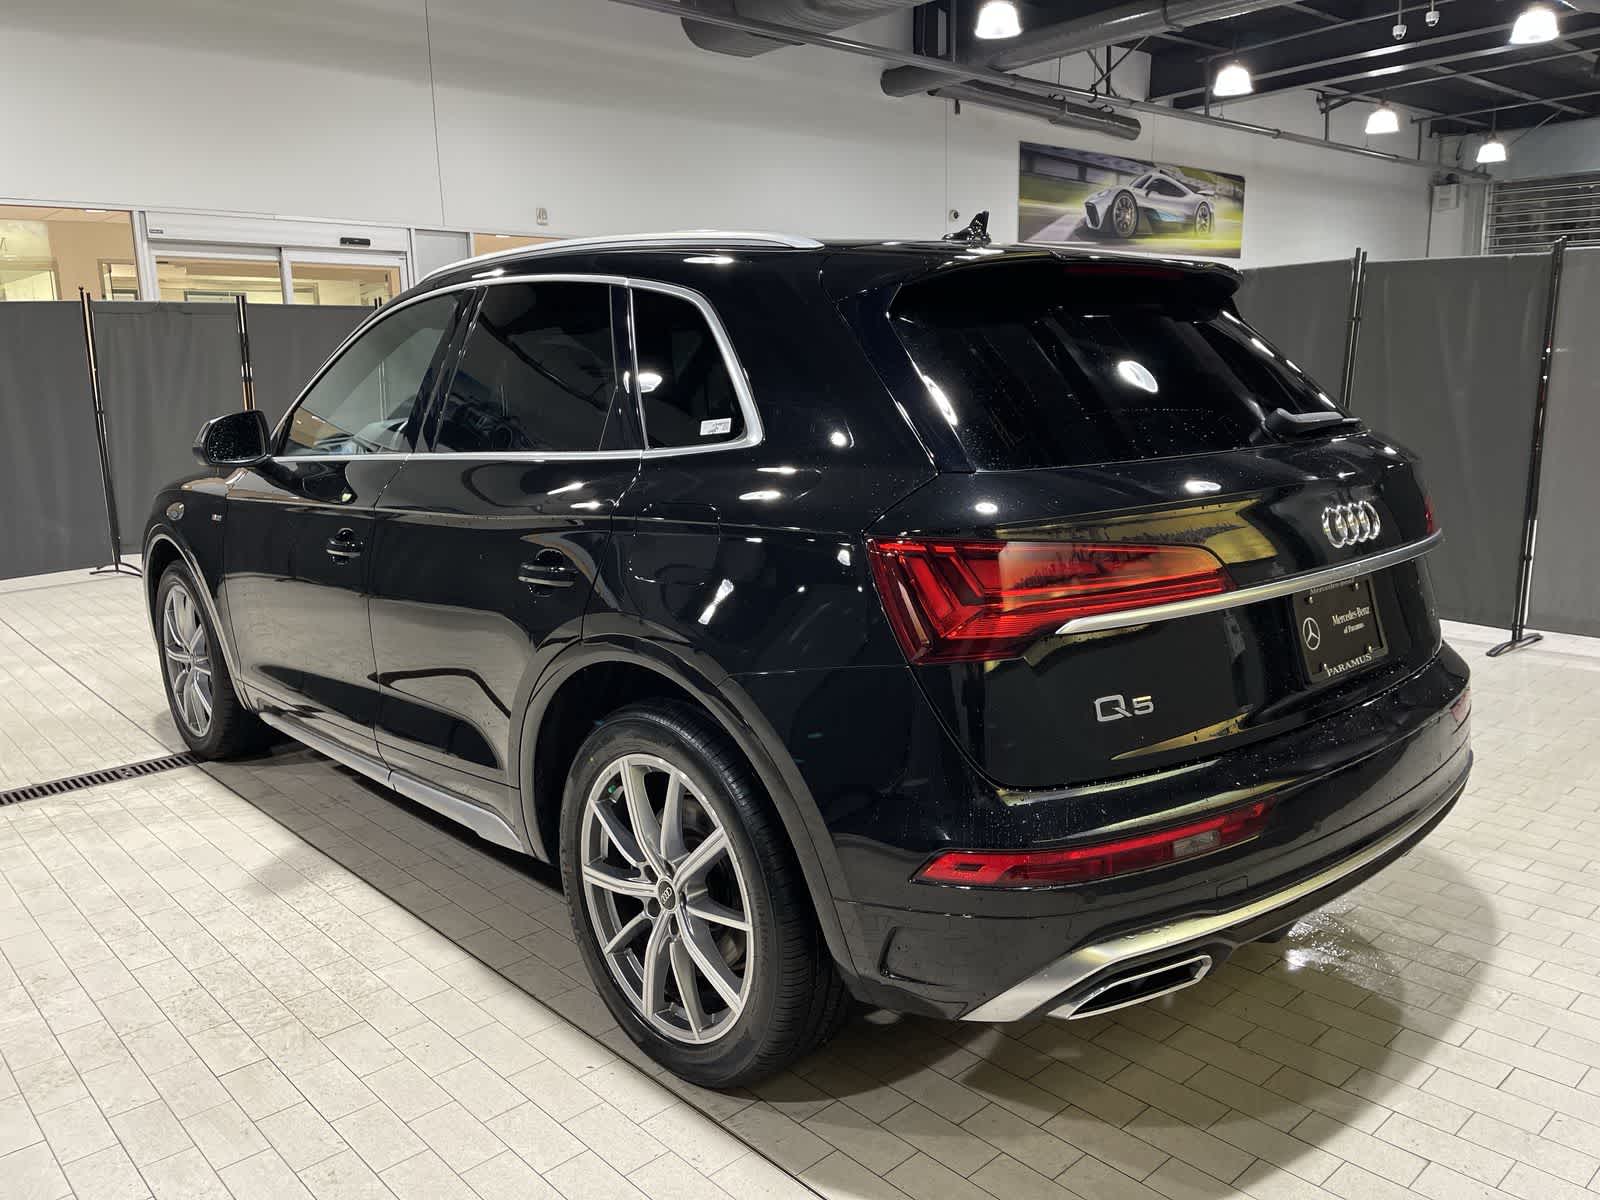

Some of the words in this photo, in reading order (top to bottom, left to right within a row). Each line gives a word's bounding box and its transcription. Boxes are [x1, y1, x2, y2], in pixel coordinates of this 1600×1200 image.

[1331, 606, 1370, 625] Mercedes-Benz
[1326, 653, 1373, 677] PARAMUS
[1094, 694, 1154, 722] Q5
